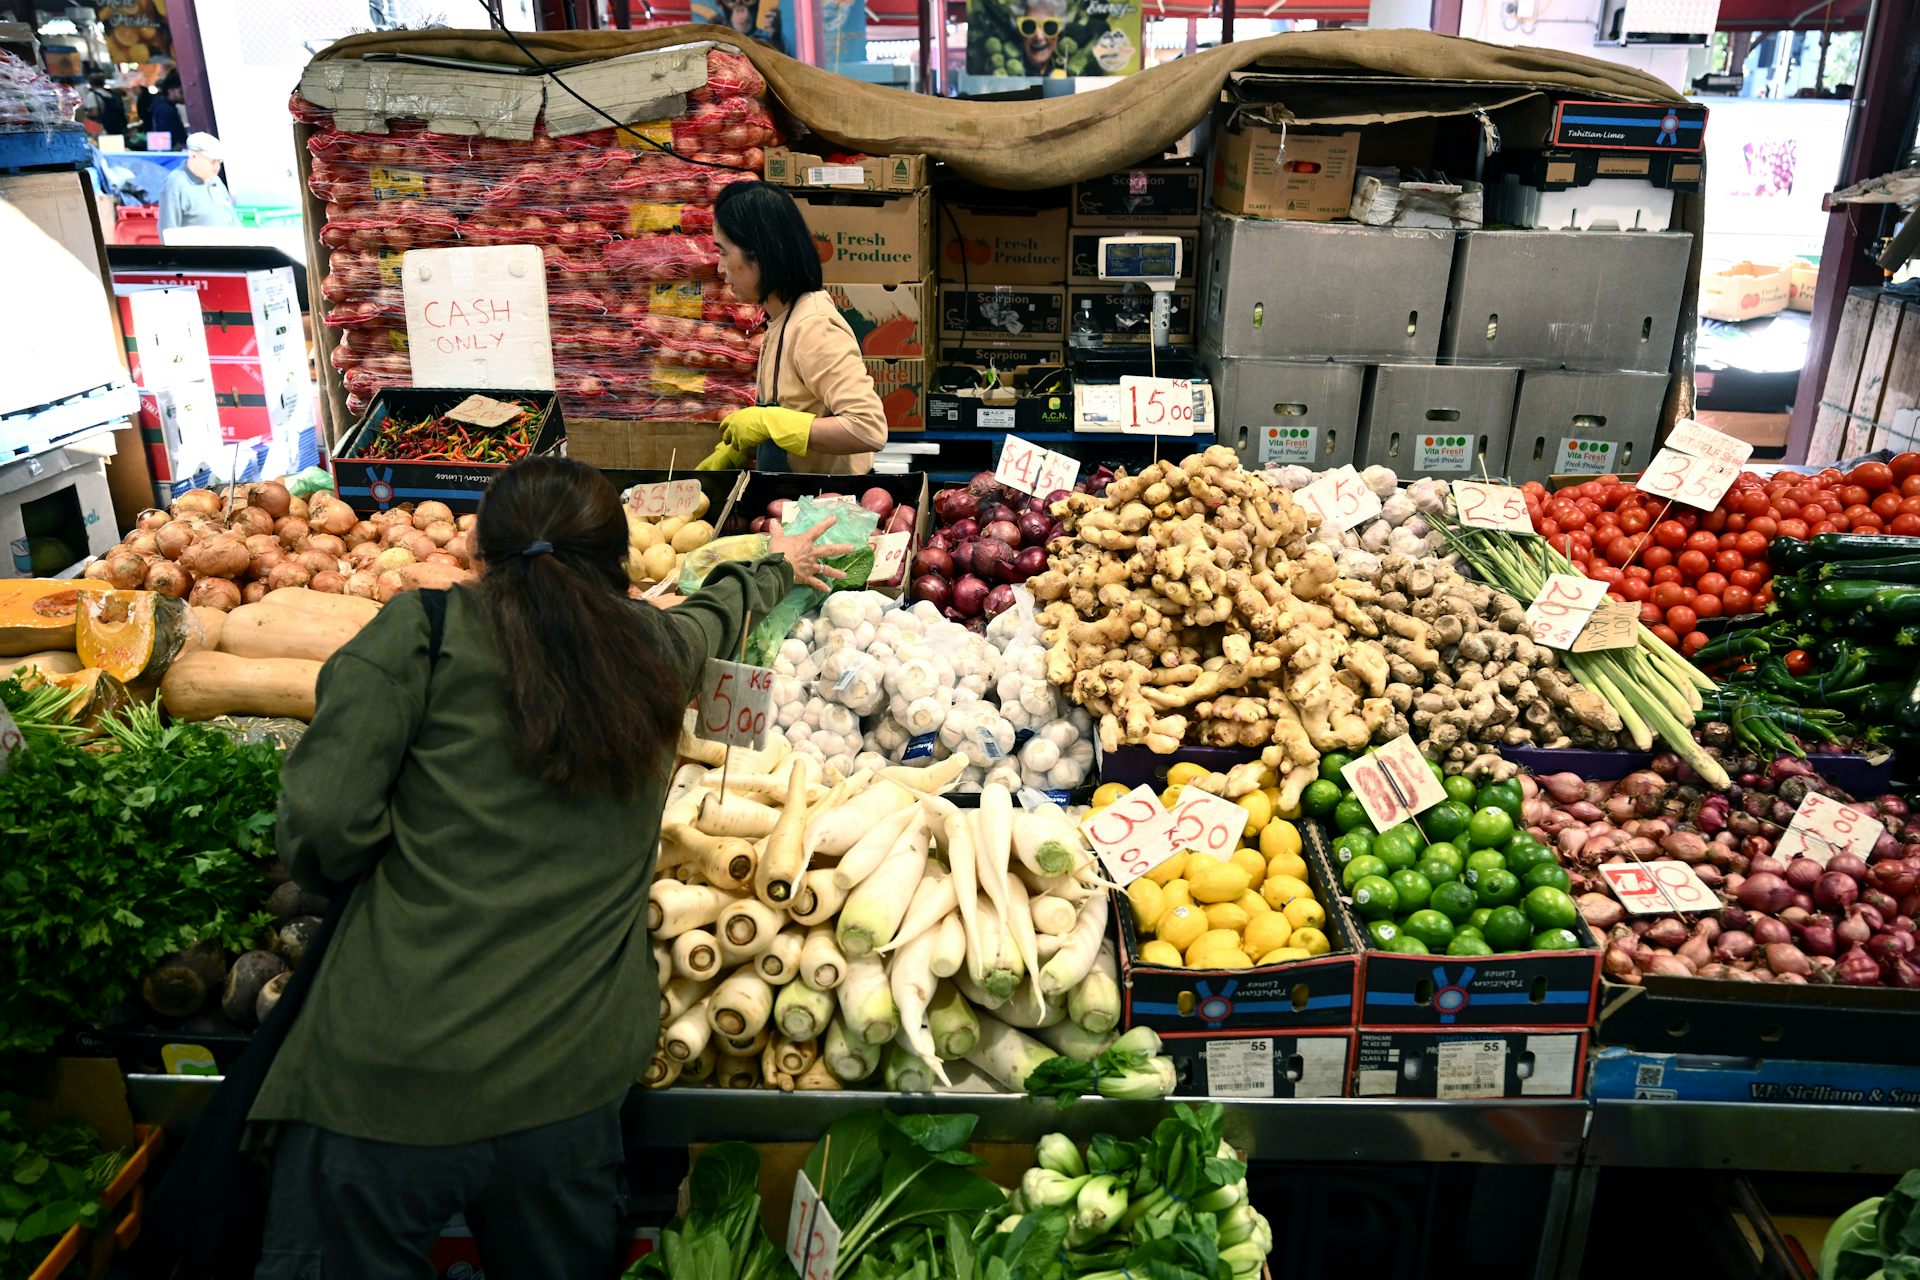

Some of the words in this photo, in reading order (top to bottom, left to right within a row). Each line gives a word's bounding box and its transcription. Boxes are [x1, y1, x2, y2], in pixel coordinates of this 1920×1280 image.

[1567, 129, 1603, 138] Tahitian
[1603, 130, 1626, 140] Limes
[1112, 175, 1165, 186] Scoion
[837, 231, 885, 246] Fresh
[995, 237, 1037, 250] Fresh
[837, 248, 912, 263] Produce
[995, 251, 1060, 265] Produce
[977, 293, 1029, 305] Scorpion
[424, 298, 511, 329] CASH
[436, 332, 505, 354] ONLY
[975, 349, 1028, 362] Scorpion
[1171, 378, 1188, 389] KG
[1128, 385, 1193, 428] 15.00
[1041, 412, 1068, 420] A.C.N.
[1285, 439, 1308, 447] Fresh
[1285, 448, 1309, 456] Produce
[1424, 447, 1440, 455] Vita
[1441, 447, 1464, 455] Fresh
[1567, 451, 1582, 460] Vita
[1583, 452, 1607, 461] Fresh
[1423, 456, 1441, 464] Fresh
[1441, 456, 1465, 464] Produce
[1563, 460, 1582, 468] Fresh
[1582, 461, 1606, 470] Produce
[435, 473, 463, 483] Limes
[464, 474, 493, 484] itian
[749, 669, 774, 692] KG
[706, 672, 767, 740] 5.00
[1484, 969, 1517, 978] Limes
[1247, 980, 1279, 988] Limes
[1472, 979, 1524, 988] Tahitian
[1235, 988, 1288, 998] Tahitian
[1251, 1041, 1267, 1051] 55
[1483, 1042, 1499, 1052] 55
[1750, 1083, 1778, 1098] V.F.
[1785, 1084, 1864, 1102] Siciliano
[1868, 1087, 1884, 1103] &
